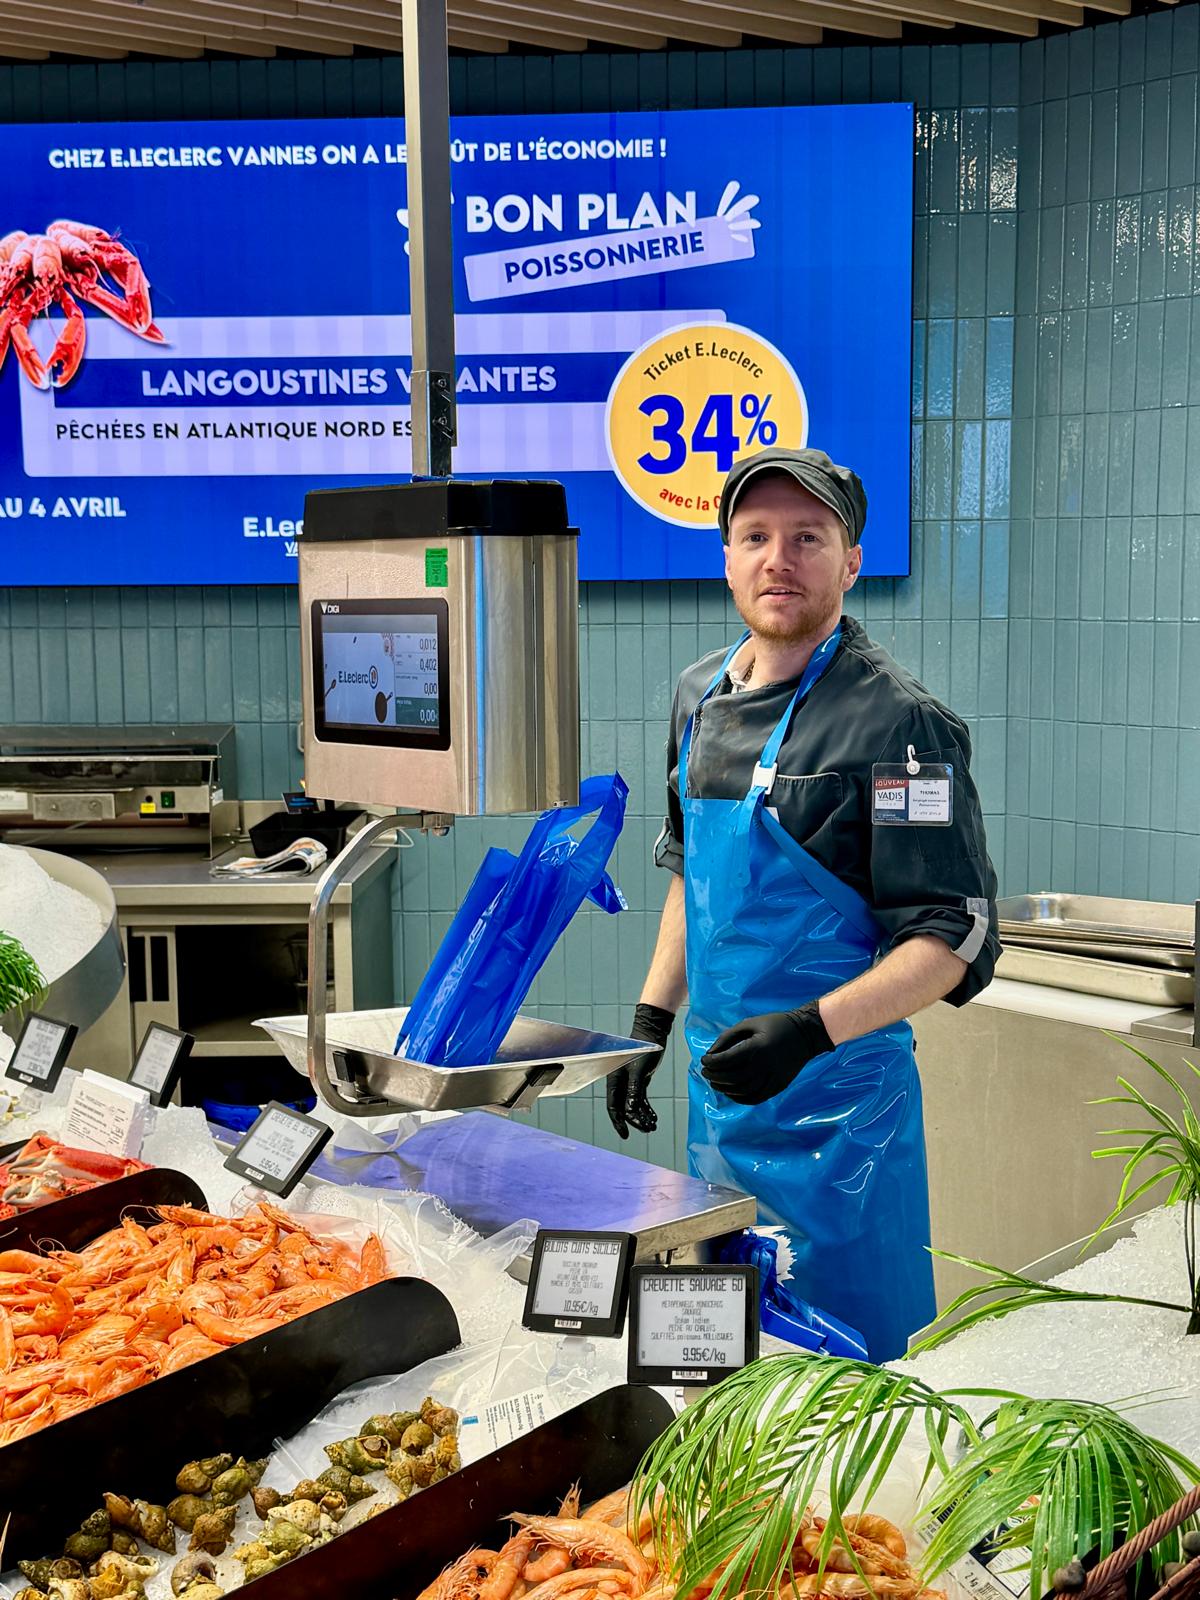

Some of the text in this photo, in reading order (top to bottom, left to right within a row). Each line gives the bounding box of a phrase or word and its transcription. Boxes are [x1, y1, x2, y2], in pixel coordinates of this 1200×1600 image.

[48, 136, 667, 169] CHEZ E.LECLERC VANNES ON A LE ÛT DE L'ÉCONOMIE !
[466, 191, 697, 233] BON PLAN
[504, 231, 705, 283] POISSONNERIE
[643, 342, 764, 381] Ticket E.Leclerc
[142, 365, 557, 396] LANGOUSTINES VANTES
[56, 418, 146, 441] PÊCHÉES
[153, 422, 180, 439] EN
[186, 421, 318, 441] ATLANTIQUE
[324, 421, 386, 438] NORD
[637, 393, 779, 475] 34%
[28, 497, 47, 518] 4
[52, 497, 127, 518] AVRIL
[659, 488, 693, 509] avec
[696, 496, 710, 511] la
[420, 639, 437, 650] 0,012
[420, 659, 437, 672] 0,402
[338, 670, 369, 684] E.Leclerc
[877, 791, 903, 801] VADIS
[643, 1278, 684, 1292] CREVETTE
[689, 1278, 727, 1292] SAUVAGE
[563, 1299, 599, 1316] 10.95€/kg
[682, 1347, 726, 1364] 9.95€/kg
